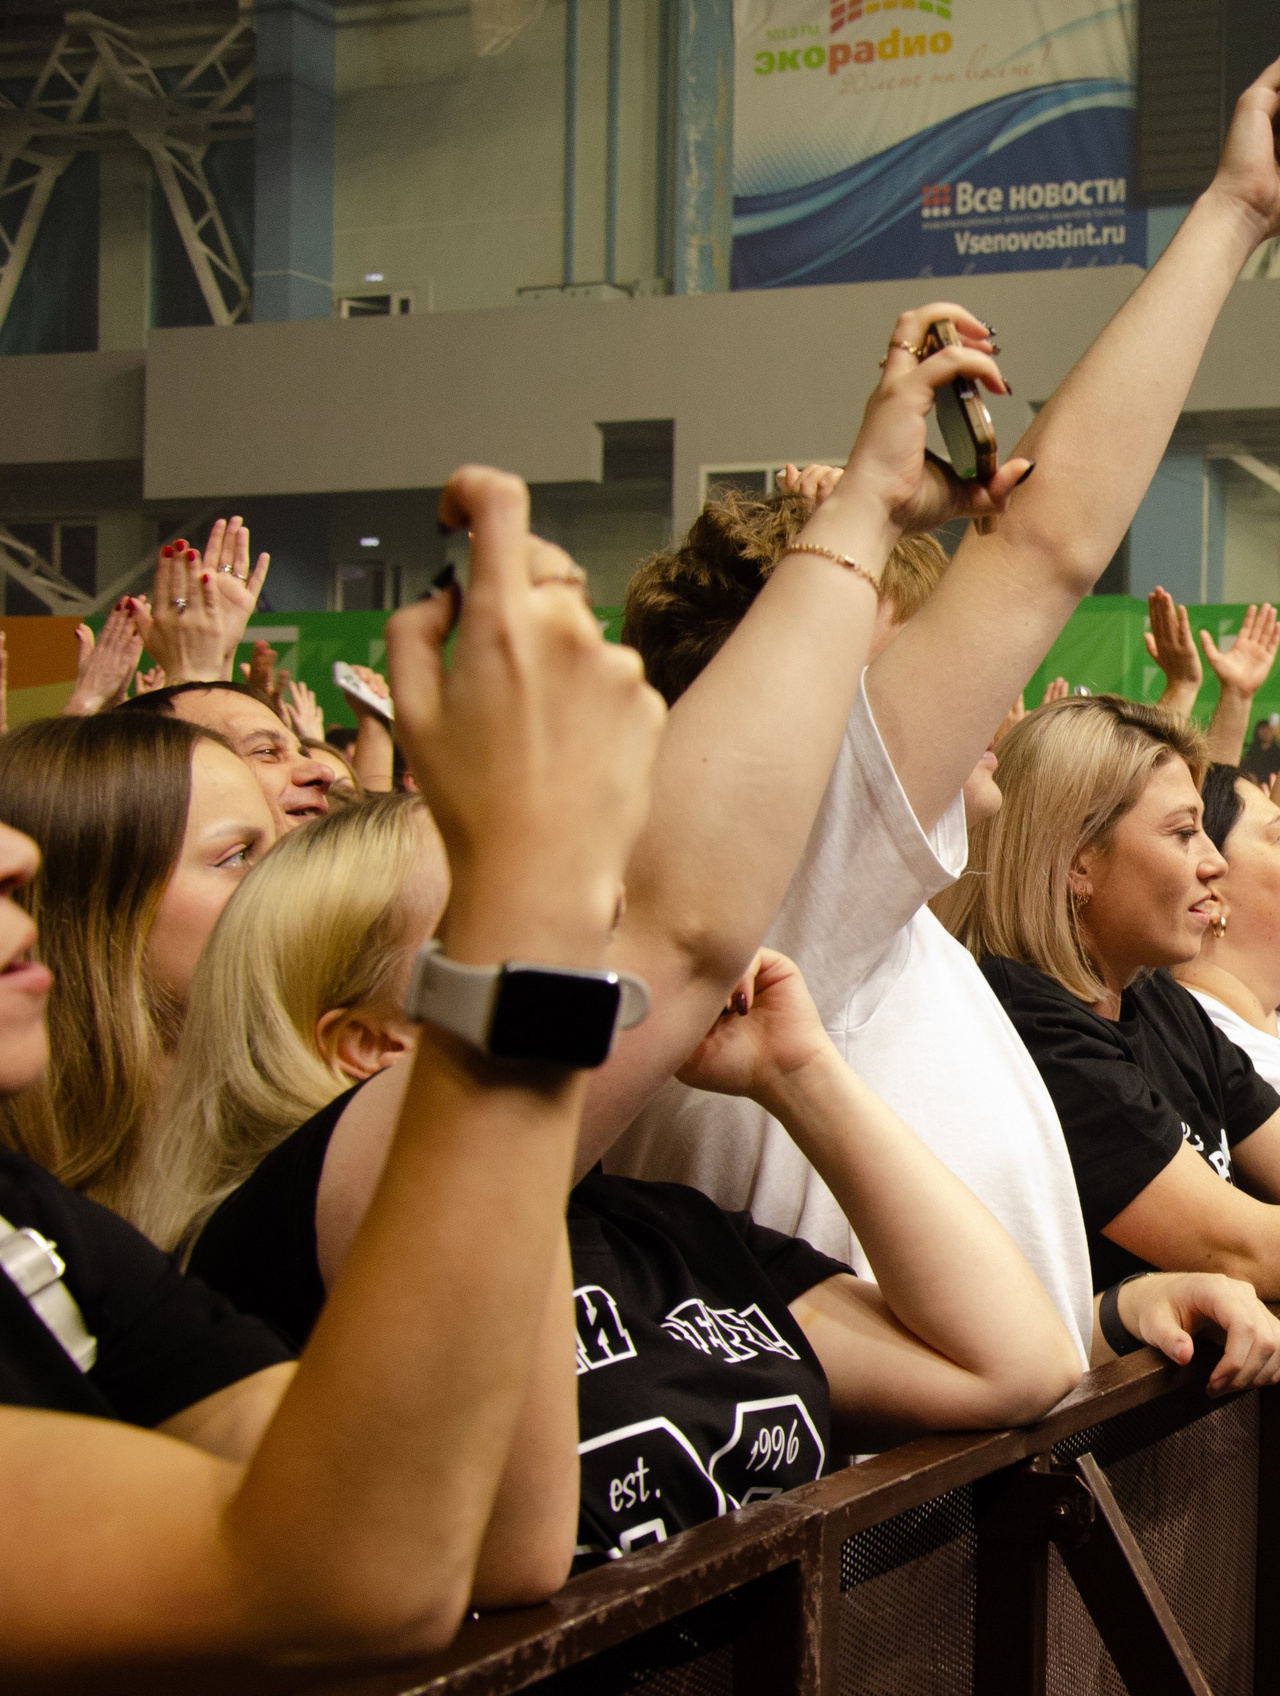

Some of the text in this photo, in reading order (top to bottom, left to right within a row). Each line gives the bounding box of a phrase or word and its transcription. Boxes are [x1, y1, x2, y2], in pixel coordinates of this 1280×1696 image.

[956, 180, 1004, 215] Все
[954, 222, 1127, 255] Vsenovostint.ru
[609, 1419, 799, 1512] est. 1996
